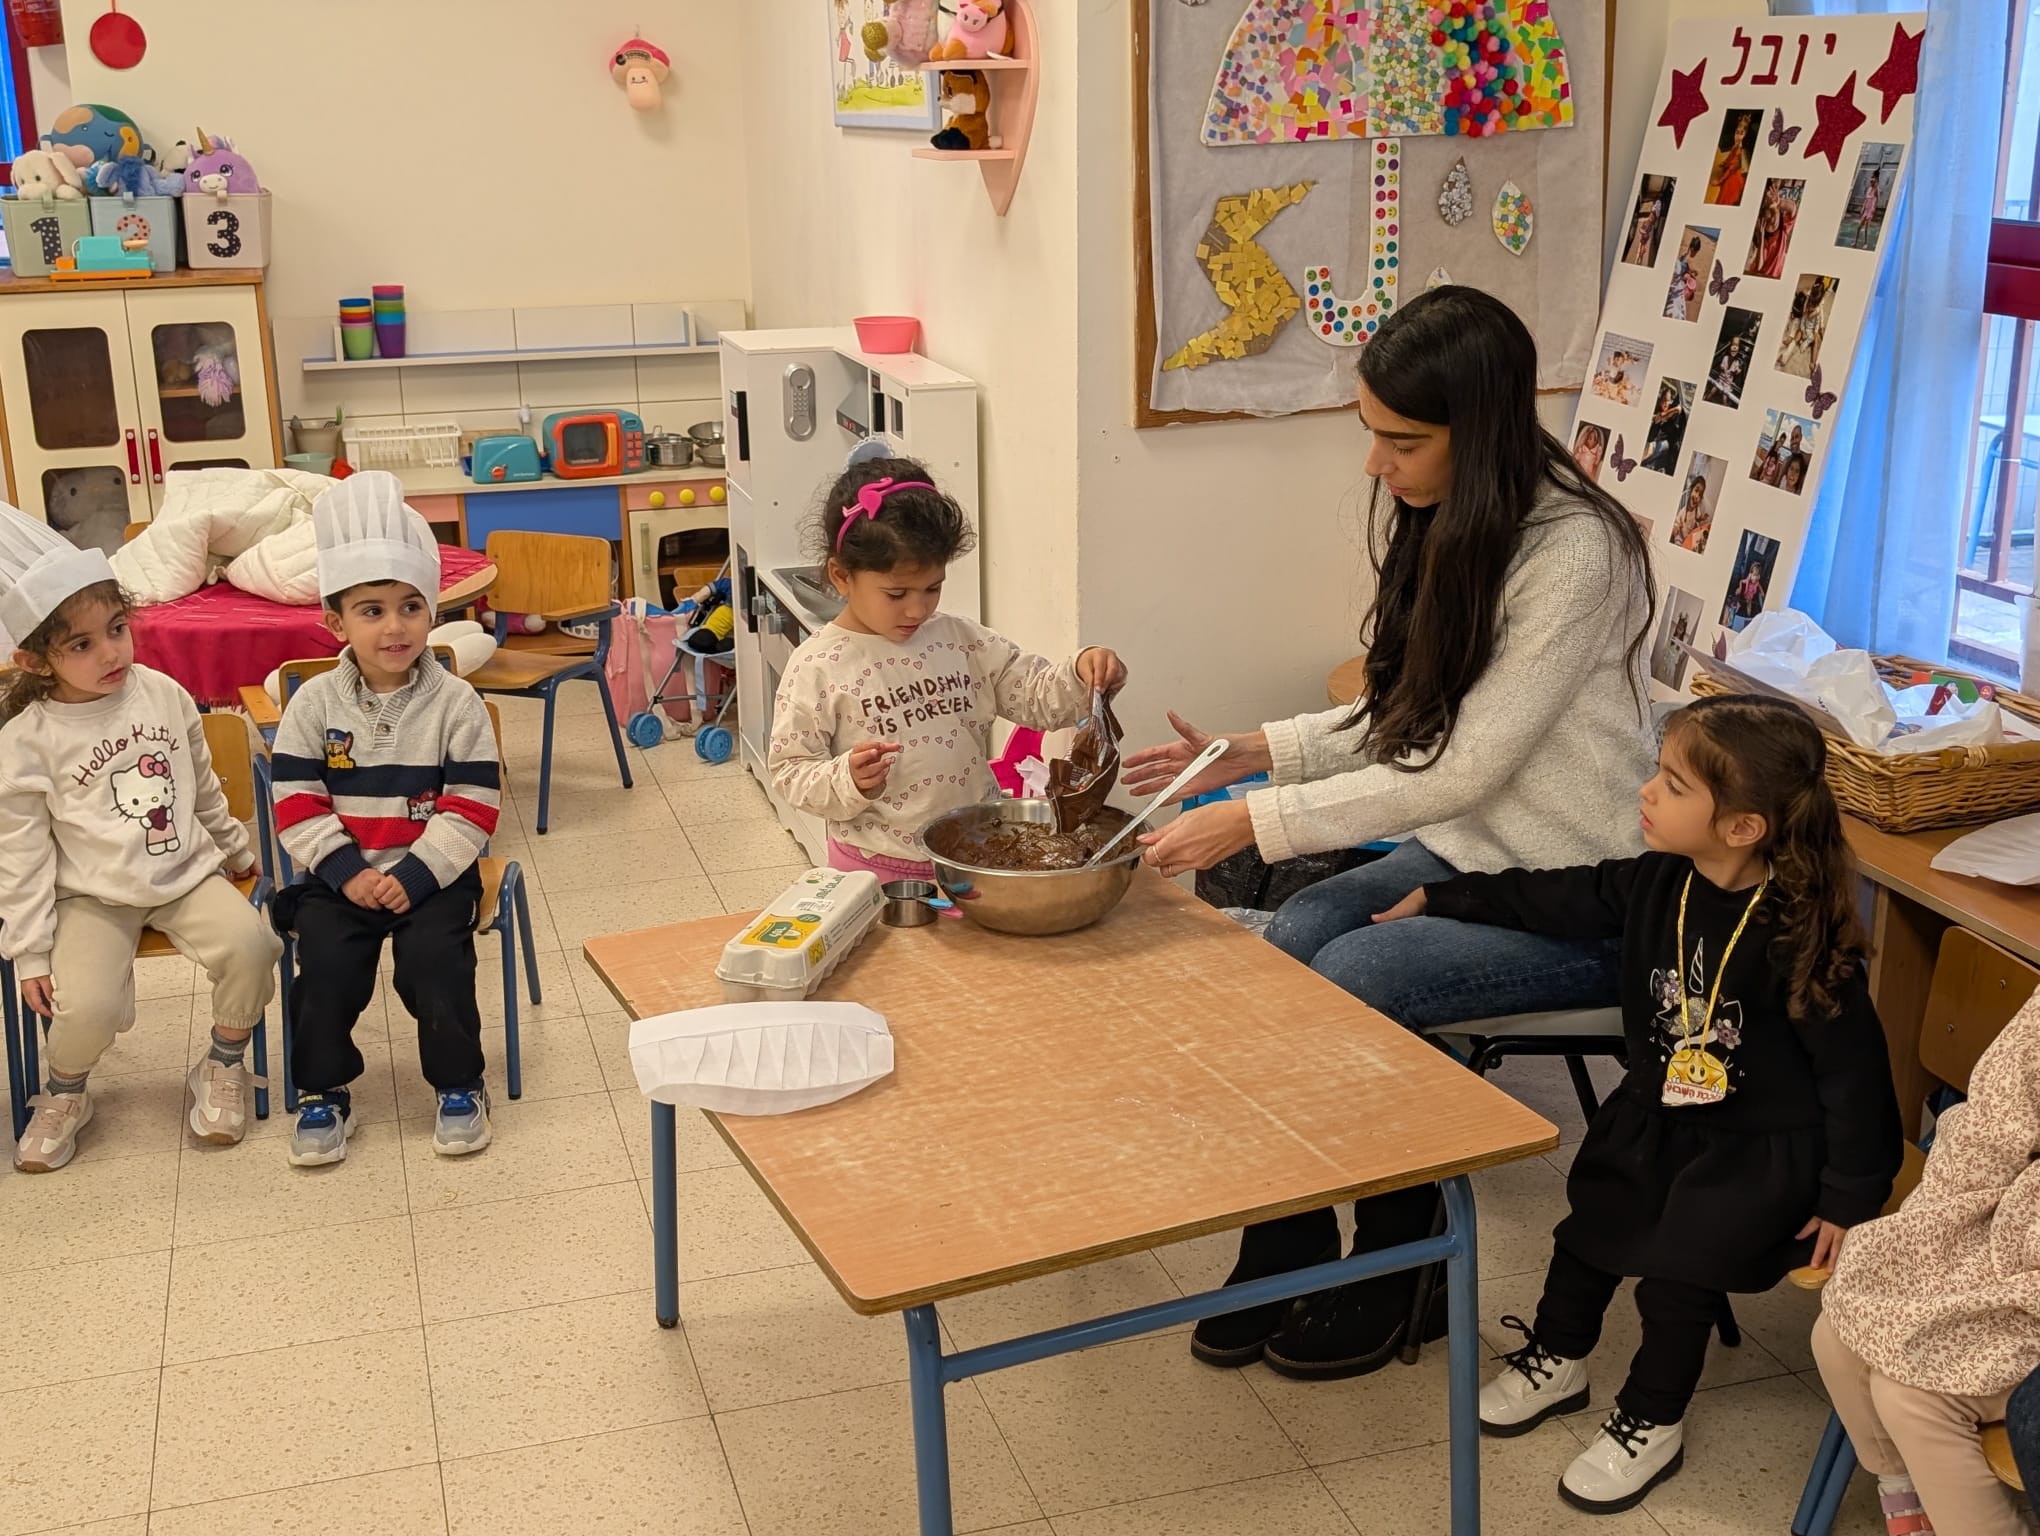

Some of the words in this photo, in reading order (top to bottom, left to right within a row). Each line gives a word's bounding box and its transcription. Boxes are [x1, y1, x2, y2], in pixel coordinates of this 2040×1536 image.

[1720, 26, 1837, 85] יובל
[30, 216, 63, 265] 1
[207, 210, 242, 258] 3
[72, 738, 129, 788] Hello
